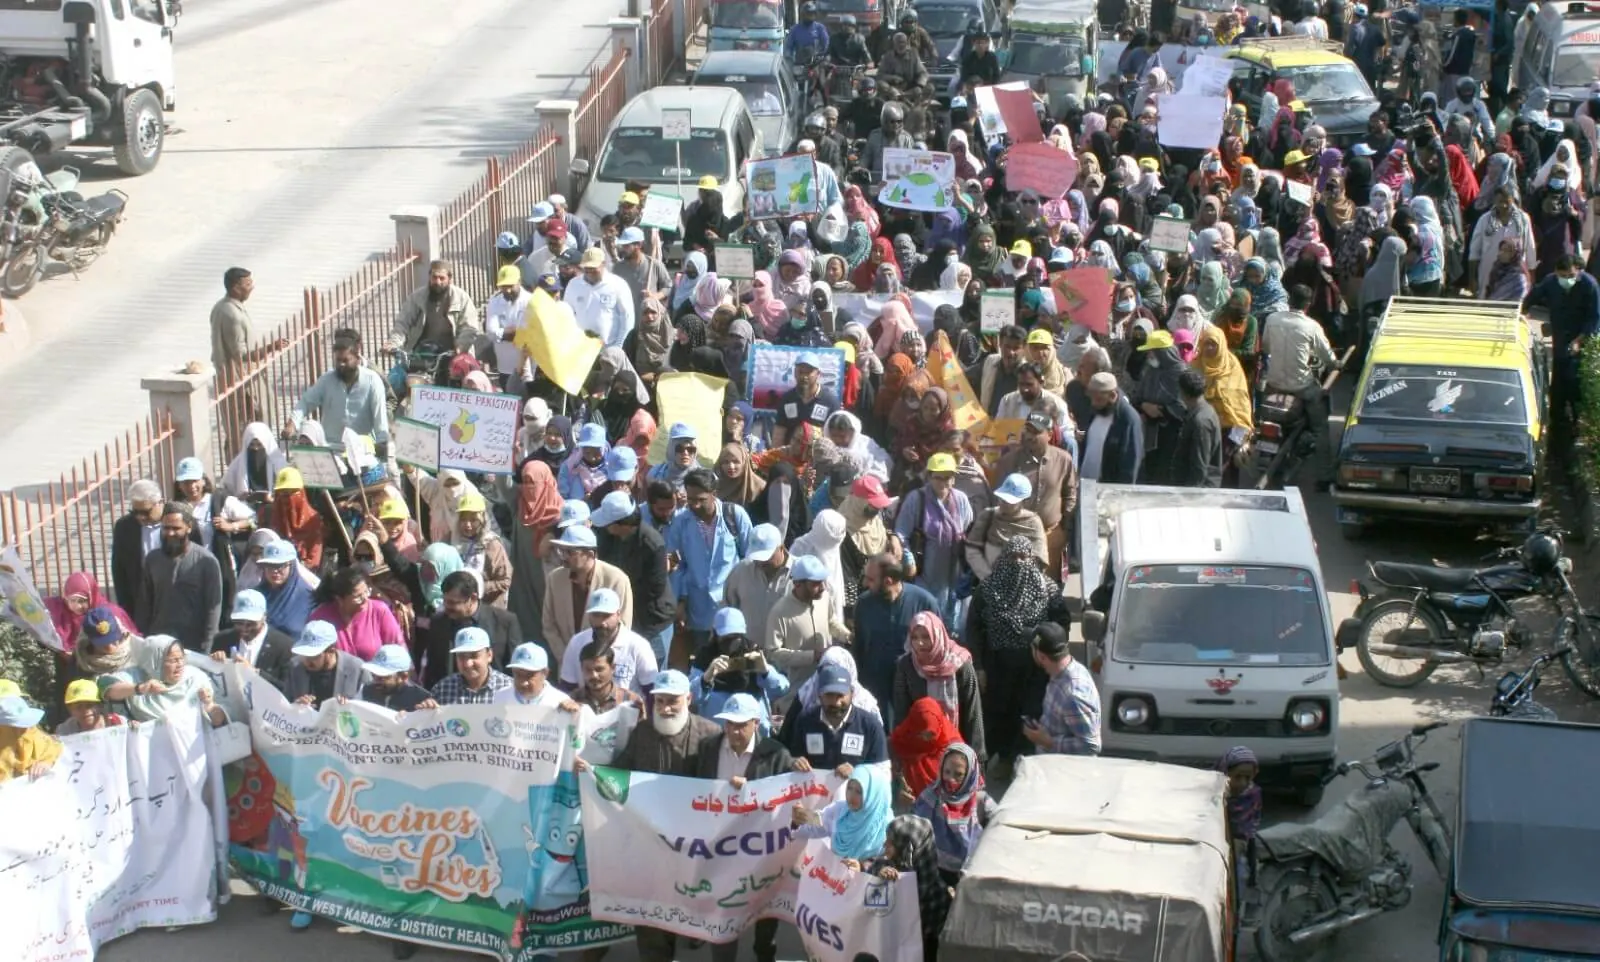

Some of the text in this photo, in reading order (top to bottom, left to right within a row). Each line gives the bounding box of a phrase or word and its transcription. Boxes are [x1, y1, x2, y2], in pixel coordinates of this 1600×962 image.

[449, 392, 471, 404] FREE
[475, 396, 517, 412] PAKISTAN
[1367, 380, 1408, 403] RIZWAN
[405, 721, 446, 740] Gavi
[383, 755, 405, 765] OF
[487, 754, 534, 772] SINDH
[413, 746, 437, 755] ON
[443, 743, 559, 765] IMMUNIZATION
[320, 769, 478, 834] Vaccines
[398, 833, 496, 897] Lives
[153, 896, 179, 906] TIME
[267, 883, 311, 908] DISTRICT
[311, 899, 344, 916] WEST
[400, 918, 455, 940] DISTRICT
[456, 928, 501, 950] HEALTH
[796, 903, 844, 952] IVES
[1022, 901, 1143, 934] SAZGAR
[545, 930, 580, 946] WEST
